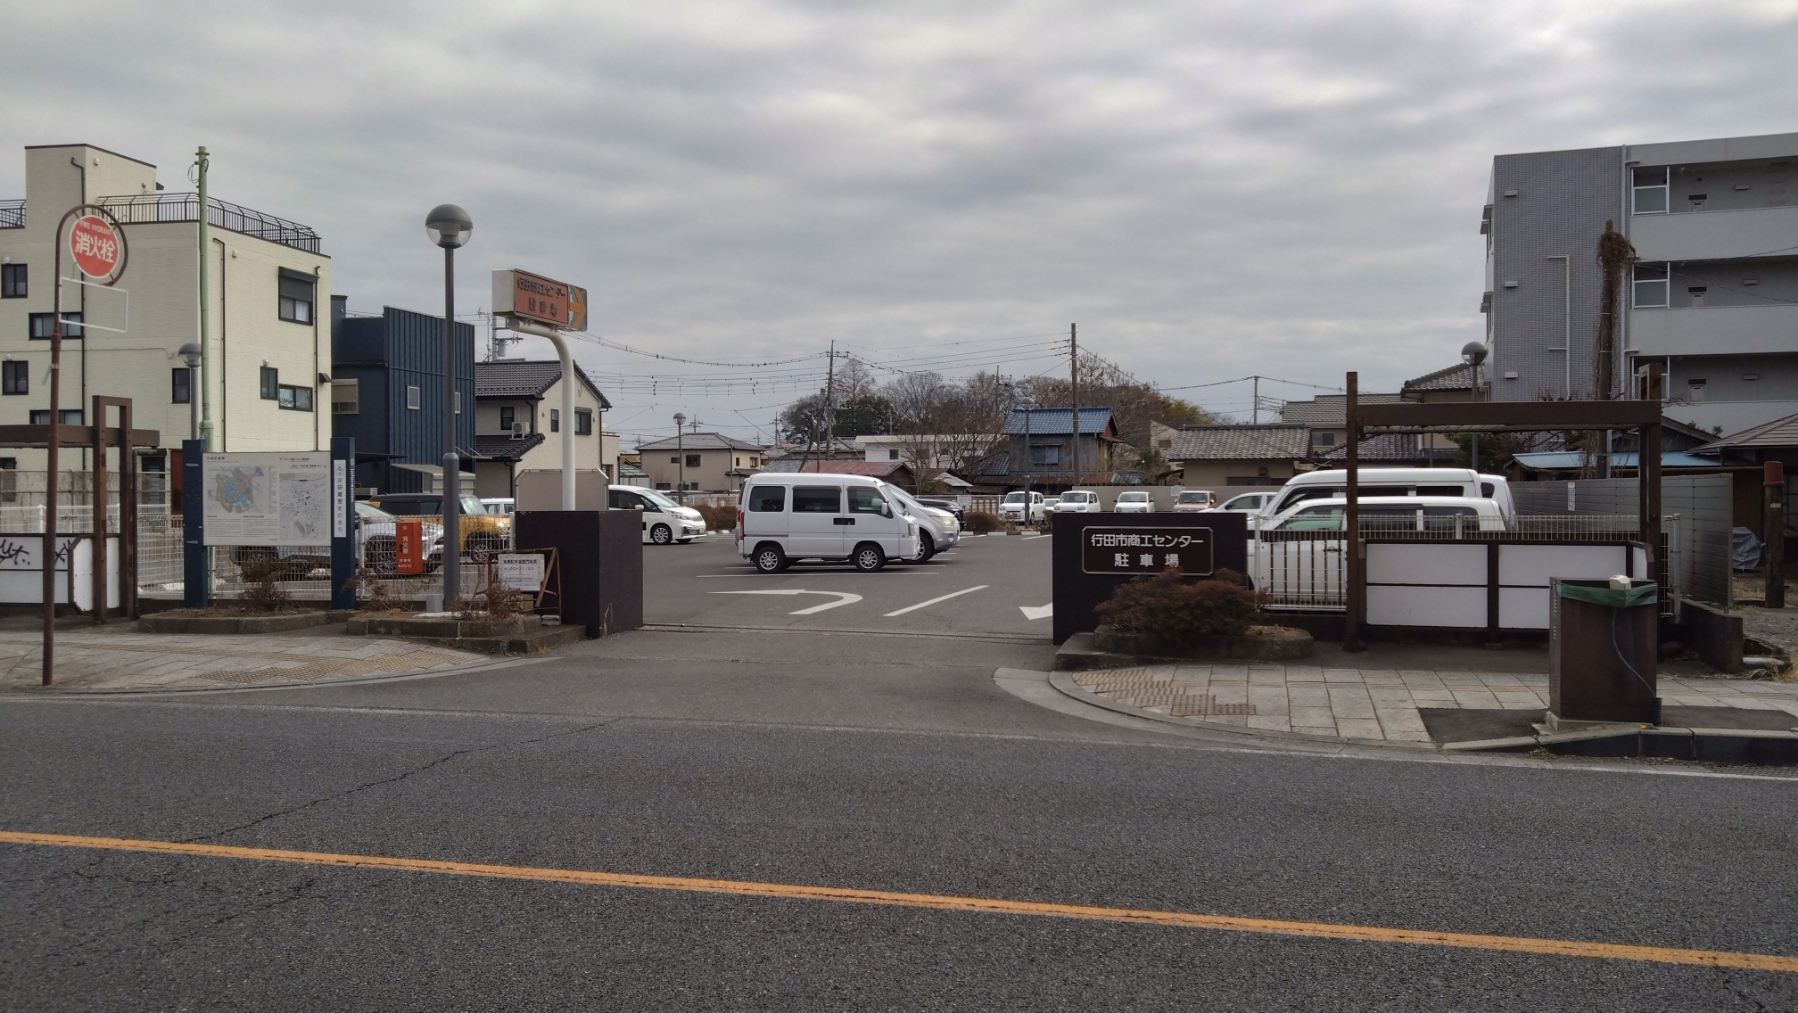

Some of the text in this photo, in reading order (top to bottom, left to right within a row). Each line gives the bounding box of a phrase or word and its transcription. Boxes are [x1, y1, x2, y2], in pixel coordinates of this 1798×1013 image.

[80, 220, 91, 229] FIRE
[75, 230, 115, 263] 消火栓
[1090, 533, 1204, 548] 行田市商工センター
[1114, 553, 1180, 567] 駐車場
